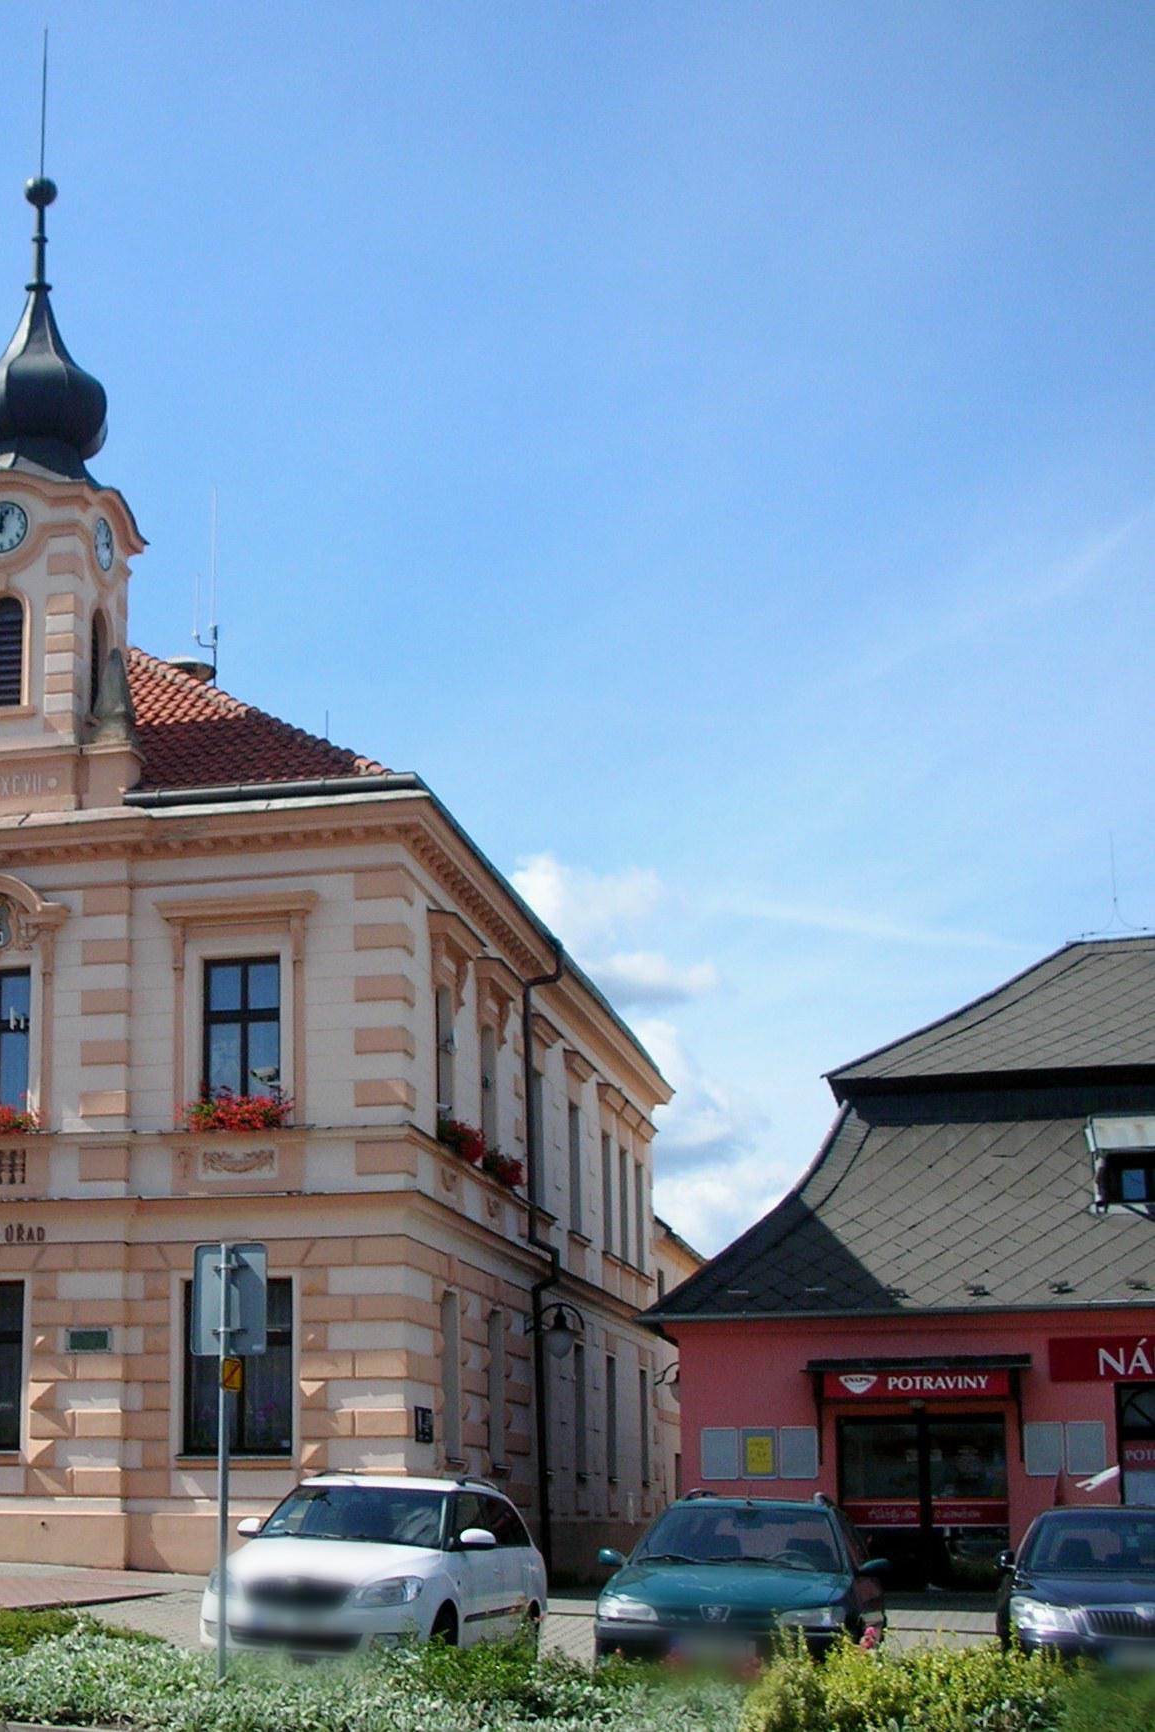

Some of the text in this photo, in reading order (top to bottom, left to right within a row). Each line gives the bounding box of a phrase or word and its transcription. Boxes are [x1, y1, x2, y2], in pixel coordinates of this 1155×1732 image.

[5, 1223, 46, 1242] ÚŘAD
[1098, 1337, 1155, 1376] NÁ
[887, 1375, 989, 1391] POTRAVINY
